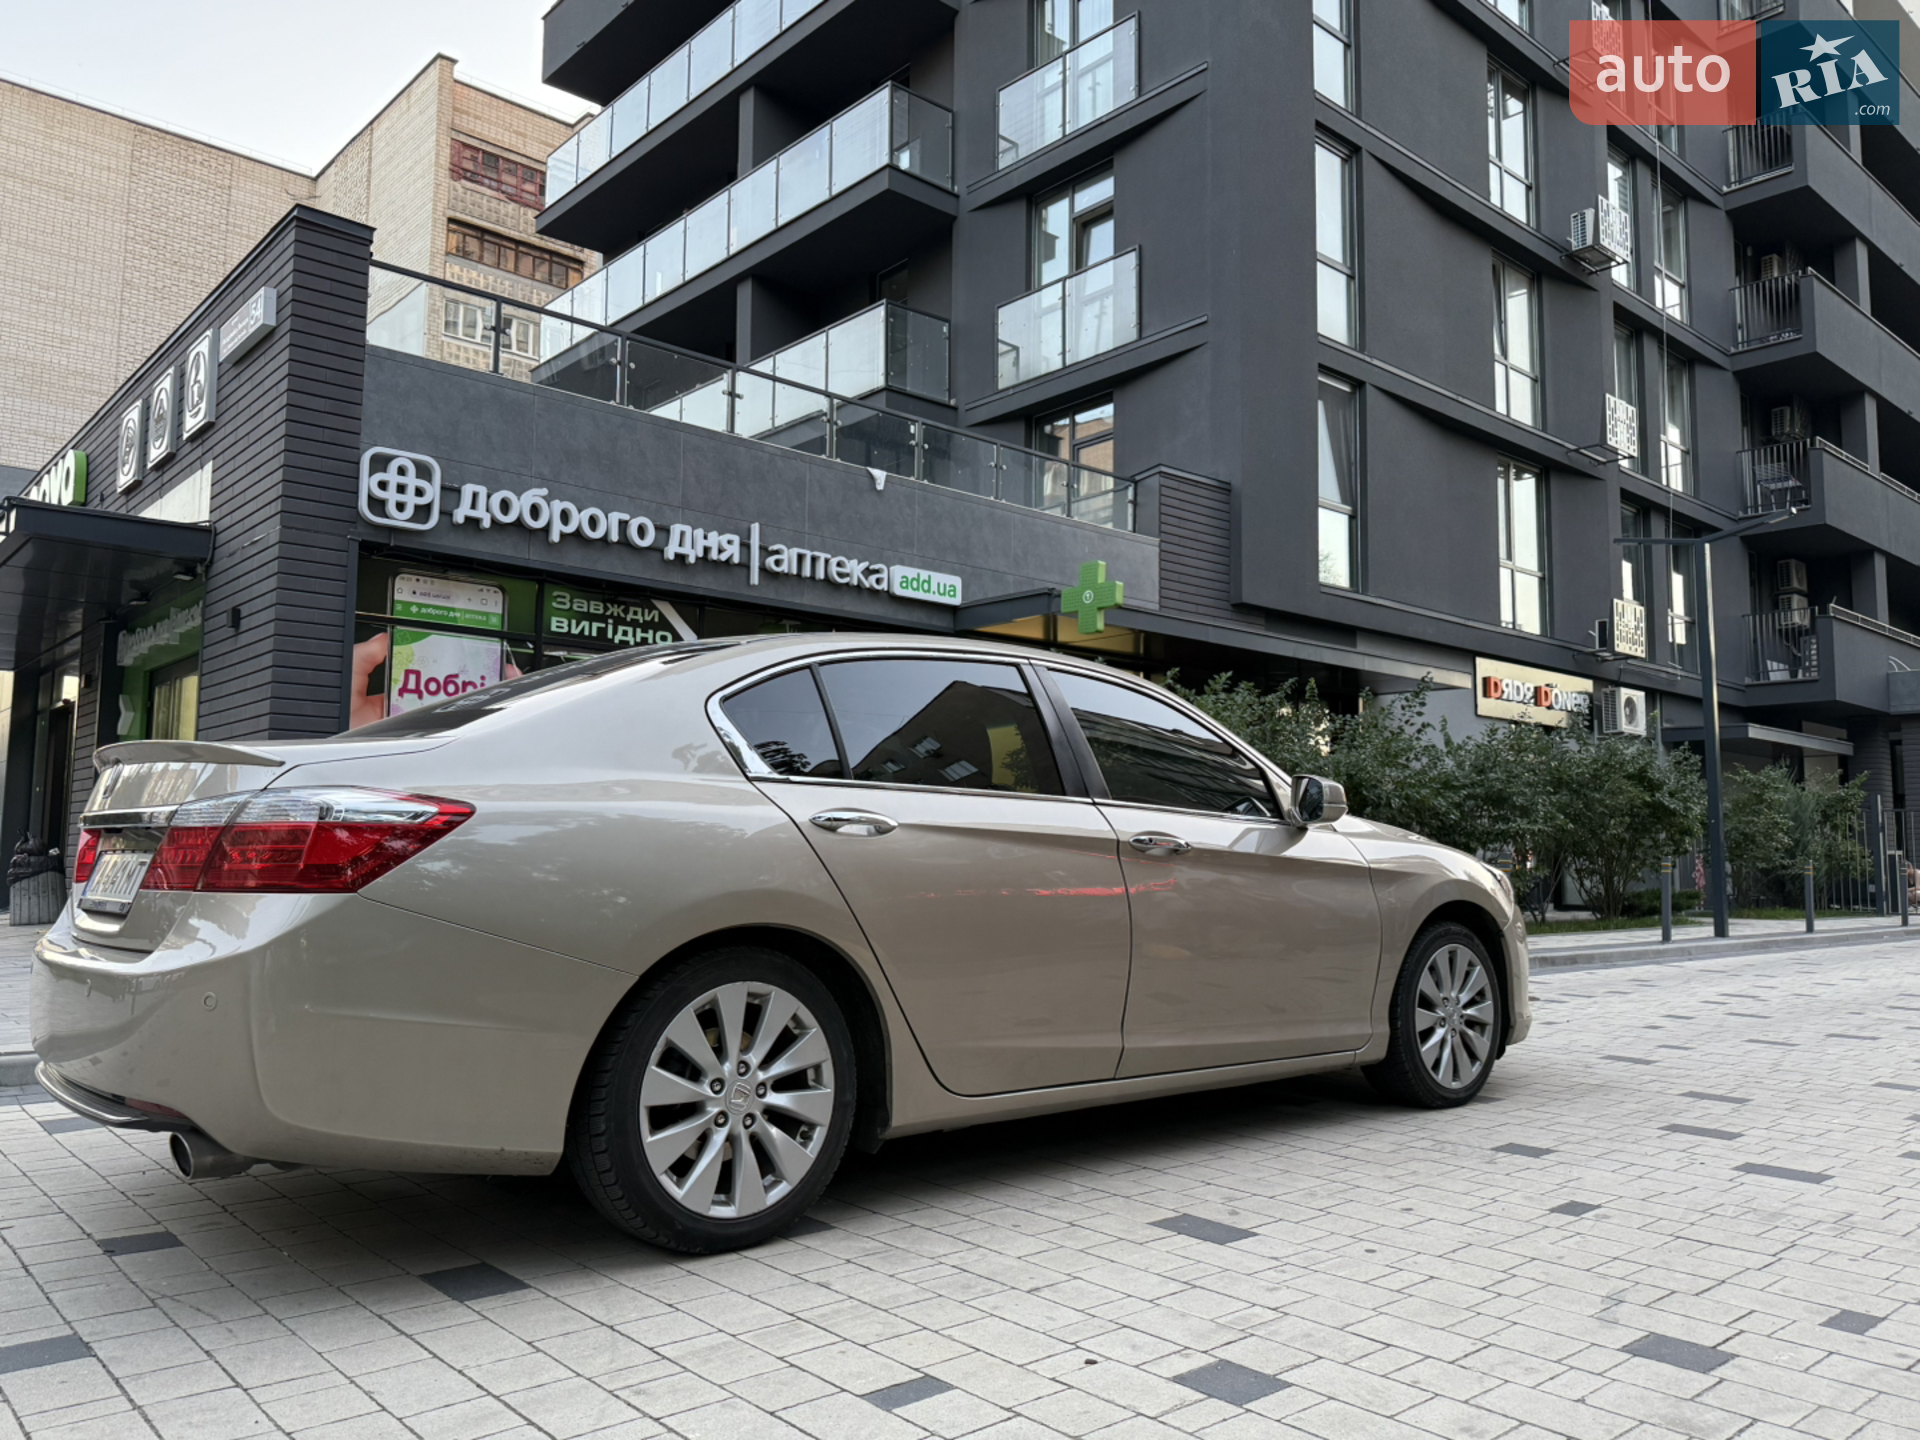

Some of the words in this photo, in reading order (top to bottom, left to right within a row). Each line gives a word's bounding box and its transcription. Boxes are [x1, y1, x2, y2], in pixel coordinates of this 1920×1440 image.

[453, 483, 656, 549] доброго
[664, 523, 741, 565] дня
[765, 543, 889, 592] аптека
[899, 572, 957, 598] add.ua
[551, 591, 660, 623] Завжди
[550, 616, 673, 646] вигідно
